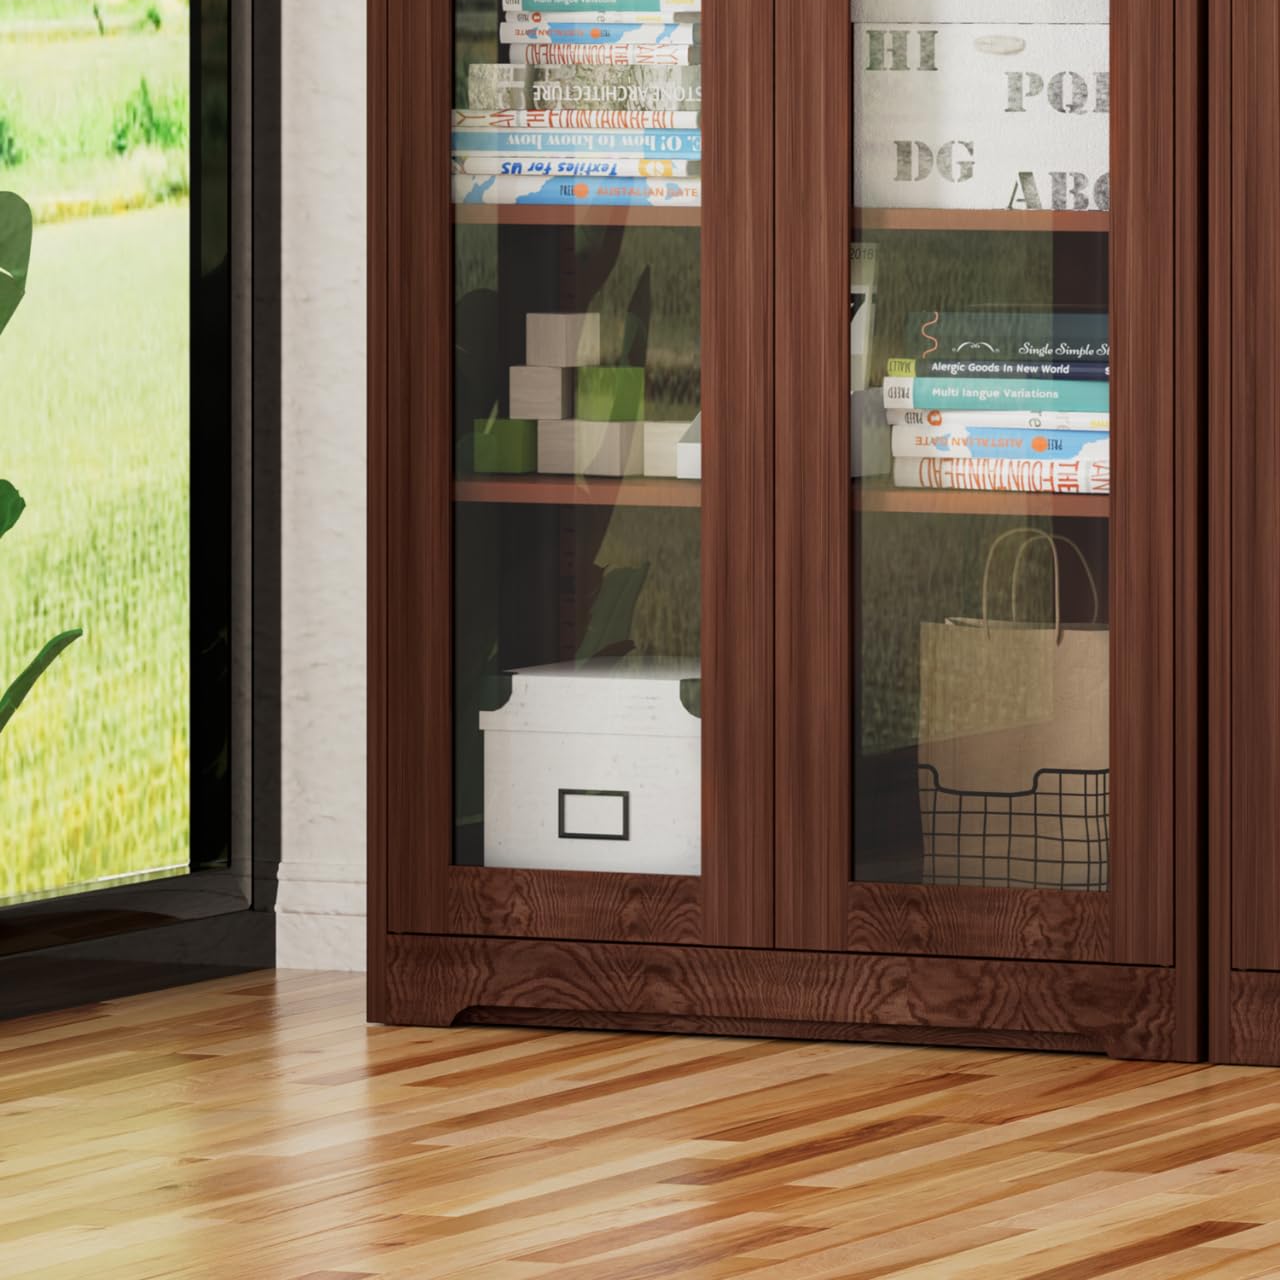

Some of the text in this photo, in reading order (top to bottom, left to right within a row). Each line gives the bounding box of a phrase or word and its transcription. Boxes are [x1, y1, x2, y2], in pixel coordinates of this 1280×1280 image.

[866, 30, 938, 71] HI
[533, 84, 649, 101] ARCHITECTURE
[507, 134, 542, 150] how
[548, 135, 593, 150] know
[597, 135, 615, 148] to
[622, 135, 656, 151] how
[527, 162, 552, 175] for
[557, 162, 617, 175] Textiles
[1018, 341, 1094, 359] Single Simple
[931, 362, 1070, 376] Alergic Goods In New World
[932, 387, 1059, 400] Multi langue Variations
[918, 457, 1055, 492] FOUNTAINHEAD
[1058, 460, 1080, 492] THE
